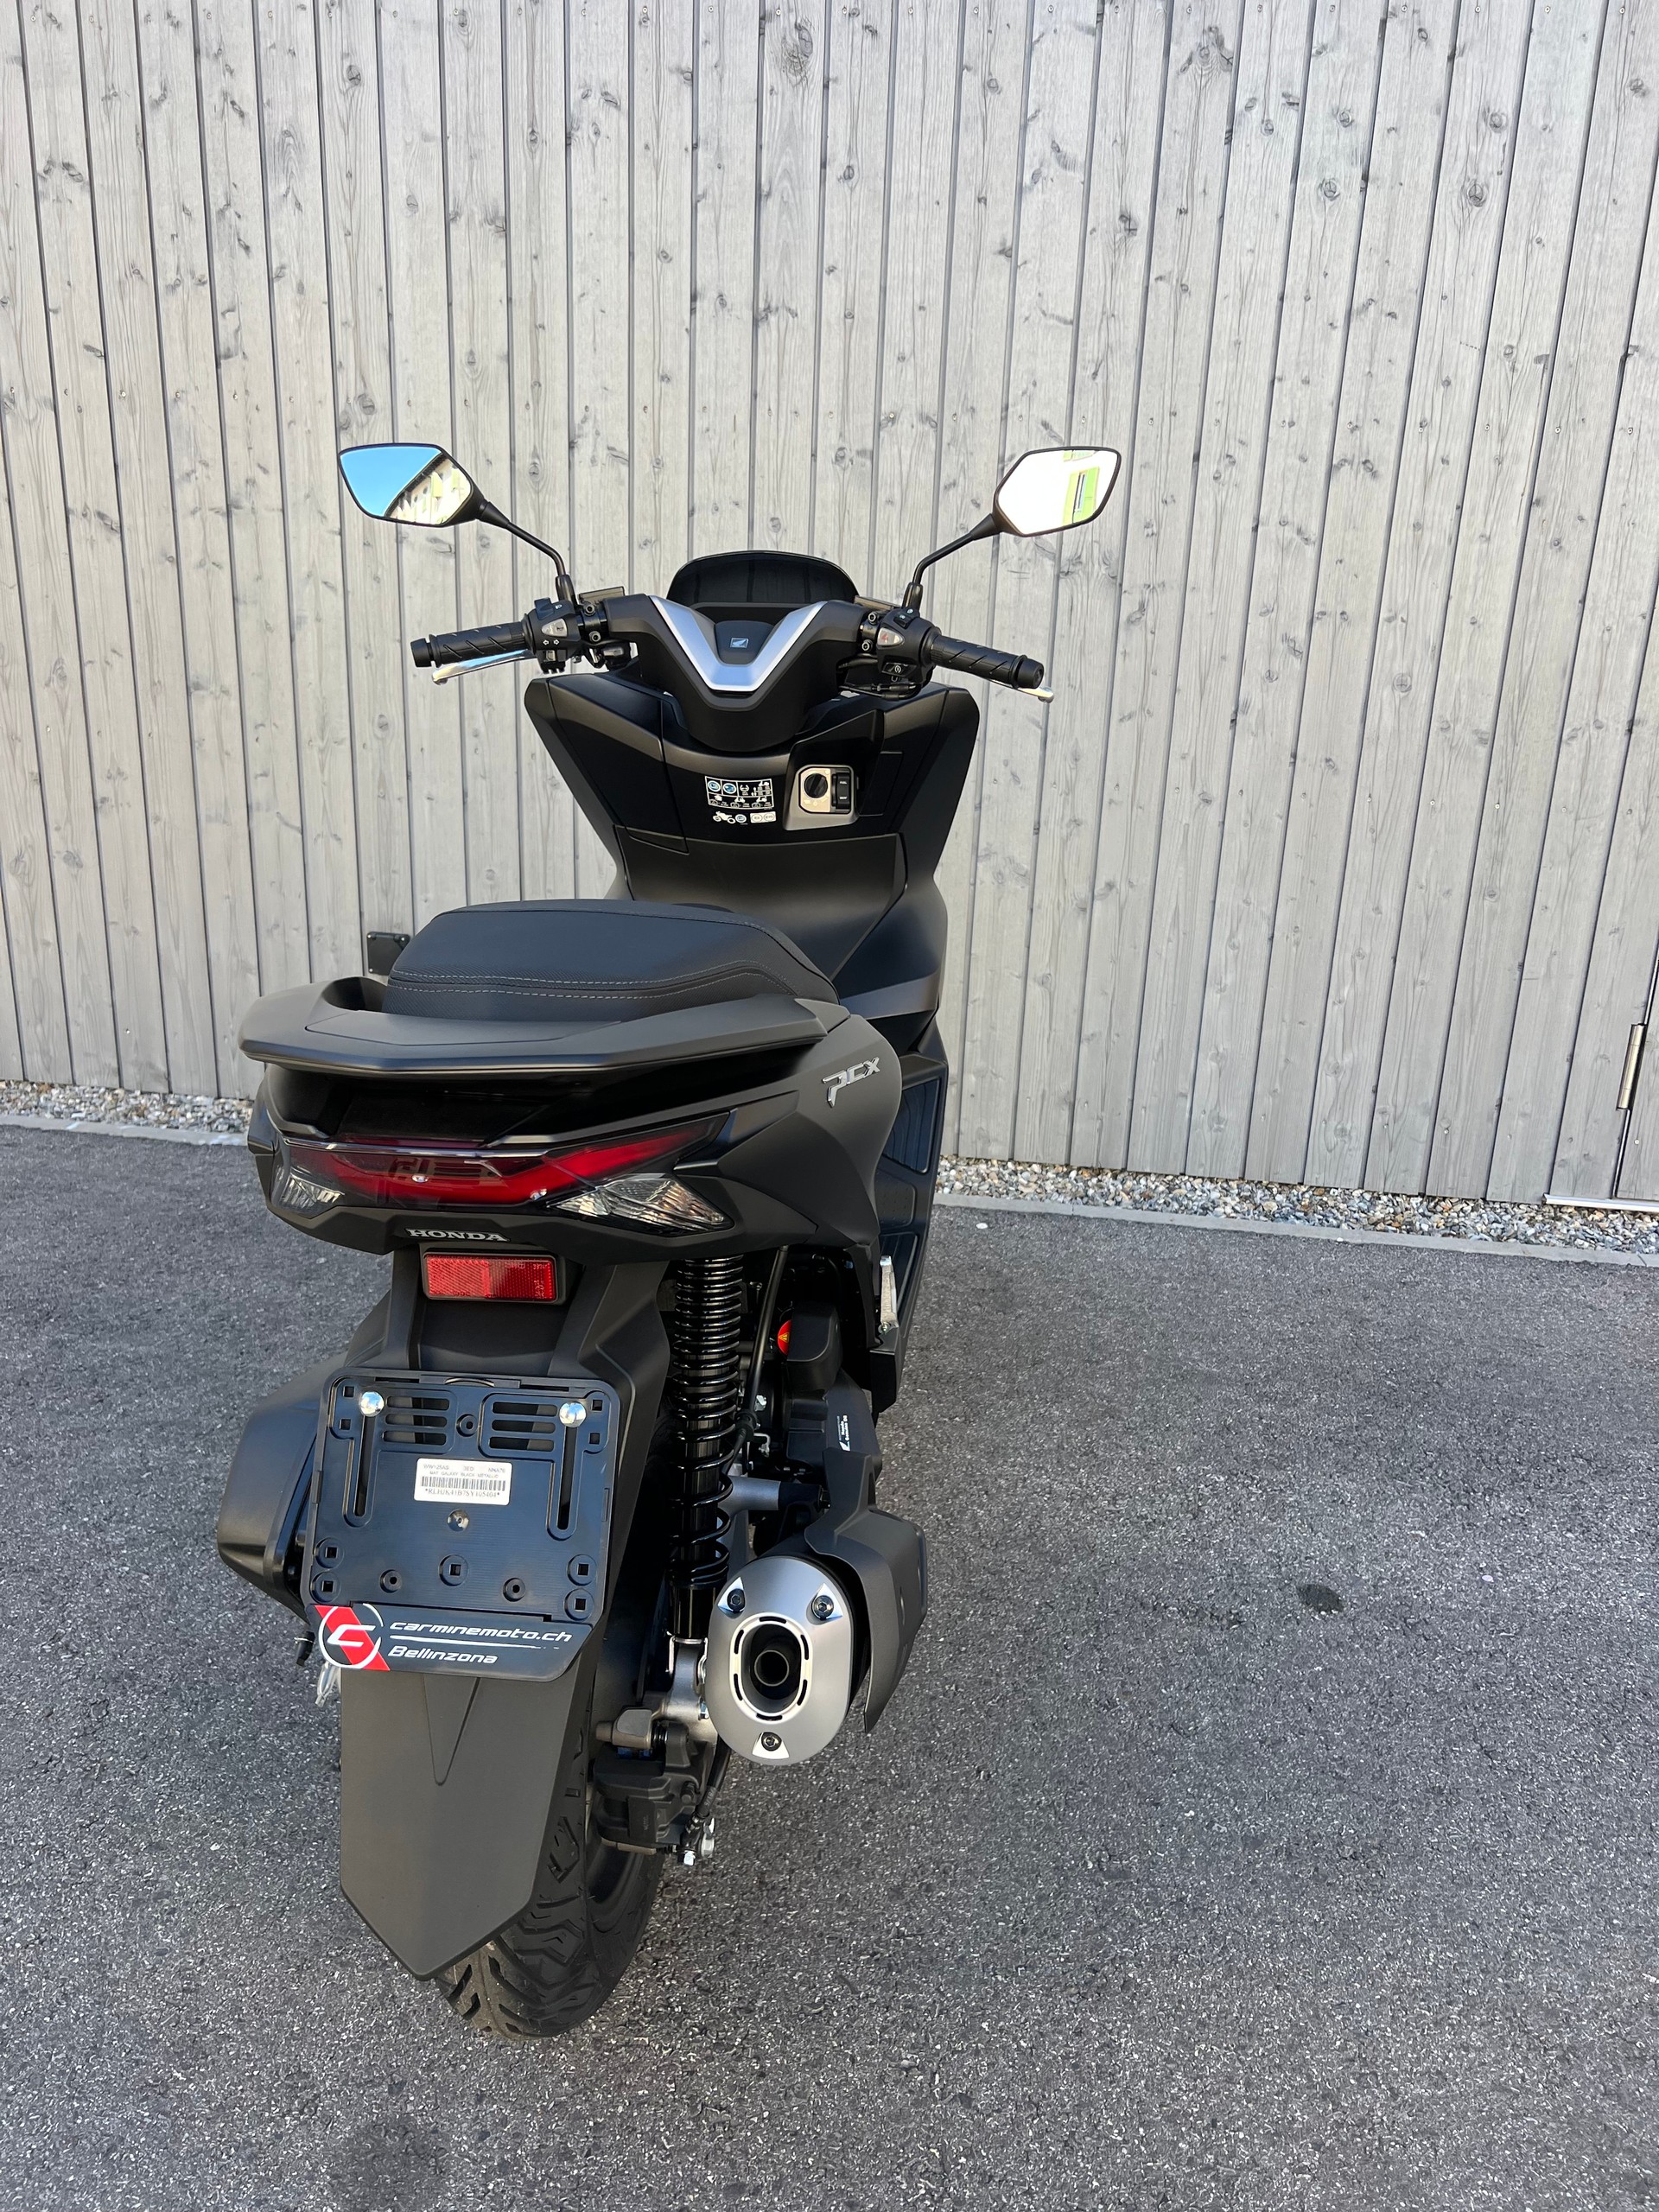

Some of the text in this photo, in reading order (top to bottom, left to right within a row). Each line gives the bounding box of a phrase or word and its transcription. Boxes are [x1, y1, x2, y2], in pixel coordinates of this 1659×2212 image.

[822, 1057, 880, 1108] PCX
[405, 1228, 511, 1242] HONDA
[389, 1621, 573, 1643] carminemoto.ch
[387, 1644, 499, 1664] Bellinzona
